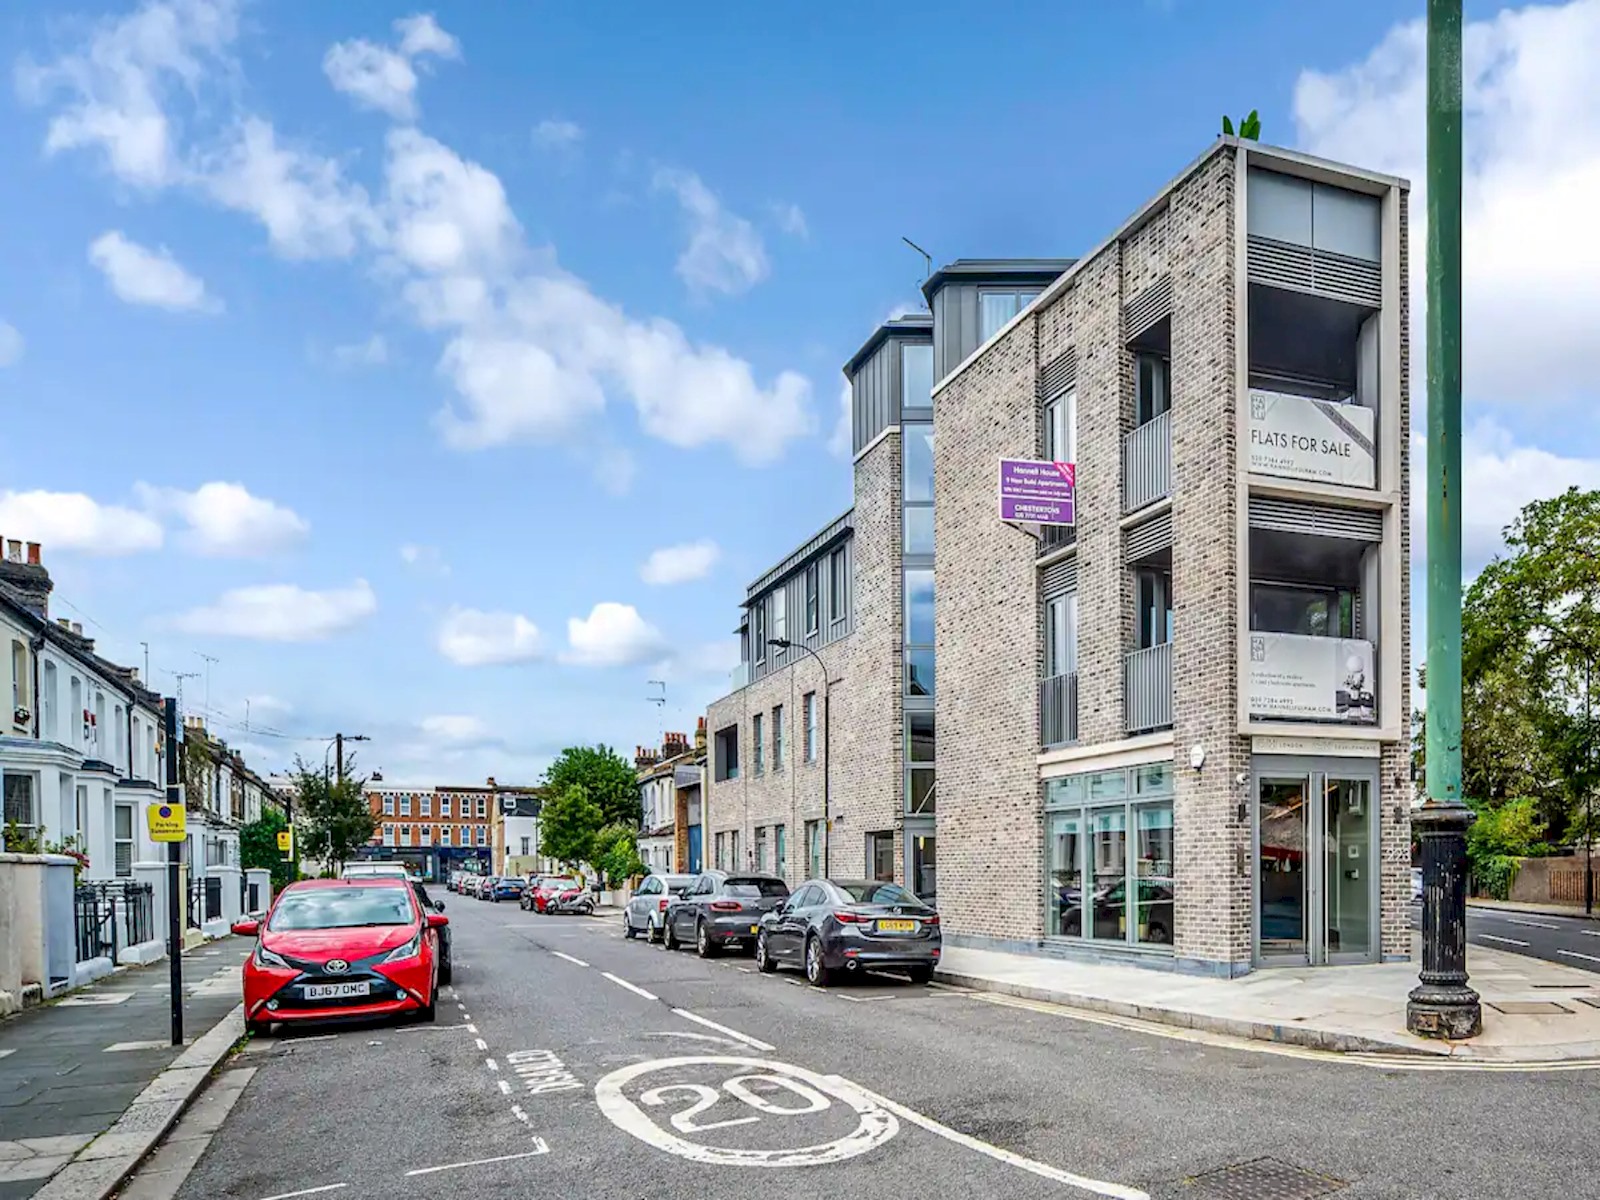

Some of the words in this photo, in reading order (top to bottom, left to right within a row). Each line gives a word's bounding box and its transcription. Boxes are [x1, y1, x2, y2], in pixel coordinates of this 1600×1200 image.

[1251, 429, 1288, 448] FLATS
[1291, 435, 1318, 453] FOR
[1320, 439, 1351, 458] SALE
[1040, 469, 1060, 477] House
[1037, 479, 1068, 488] Apartments
[1014, 504, 1060, 514] CHESTERTONS
[309, 984, 339, 998] BJ67
[640, 1073, 832, 1134] 20
